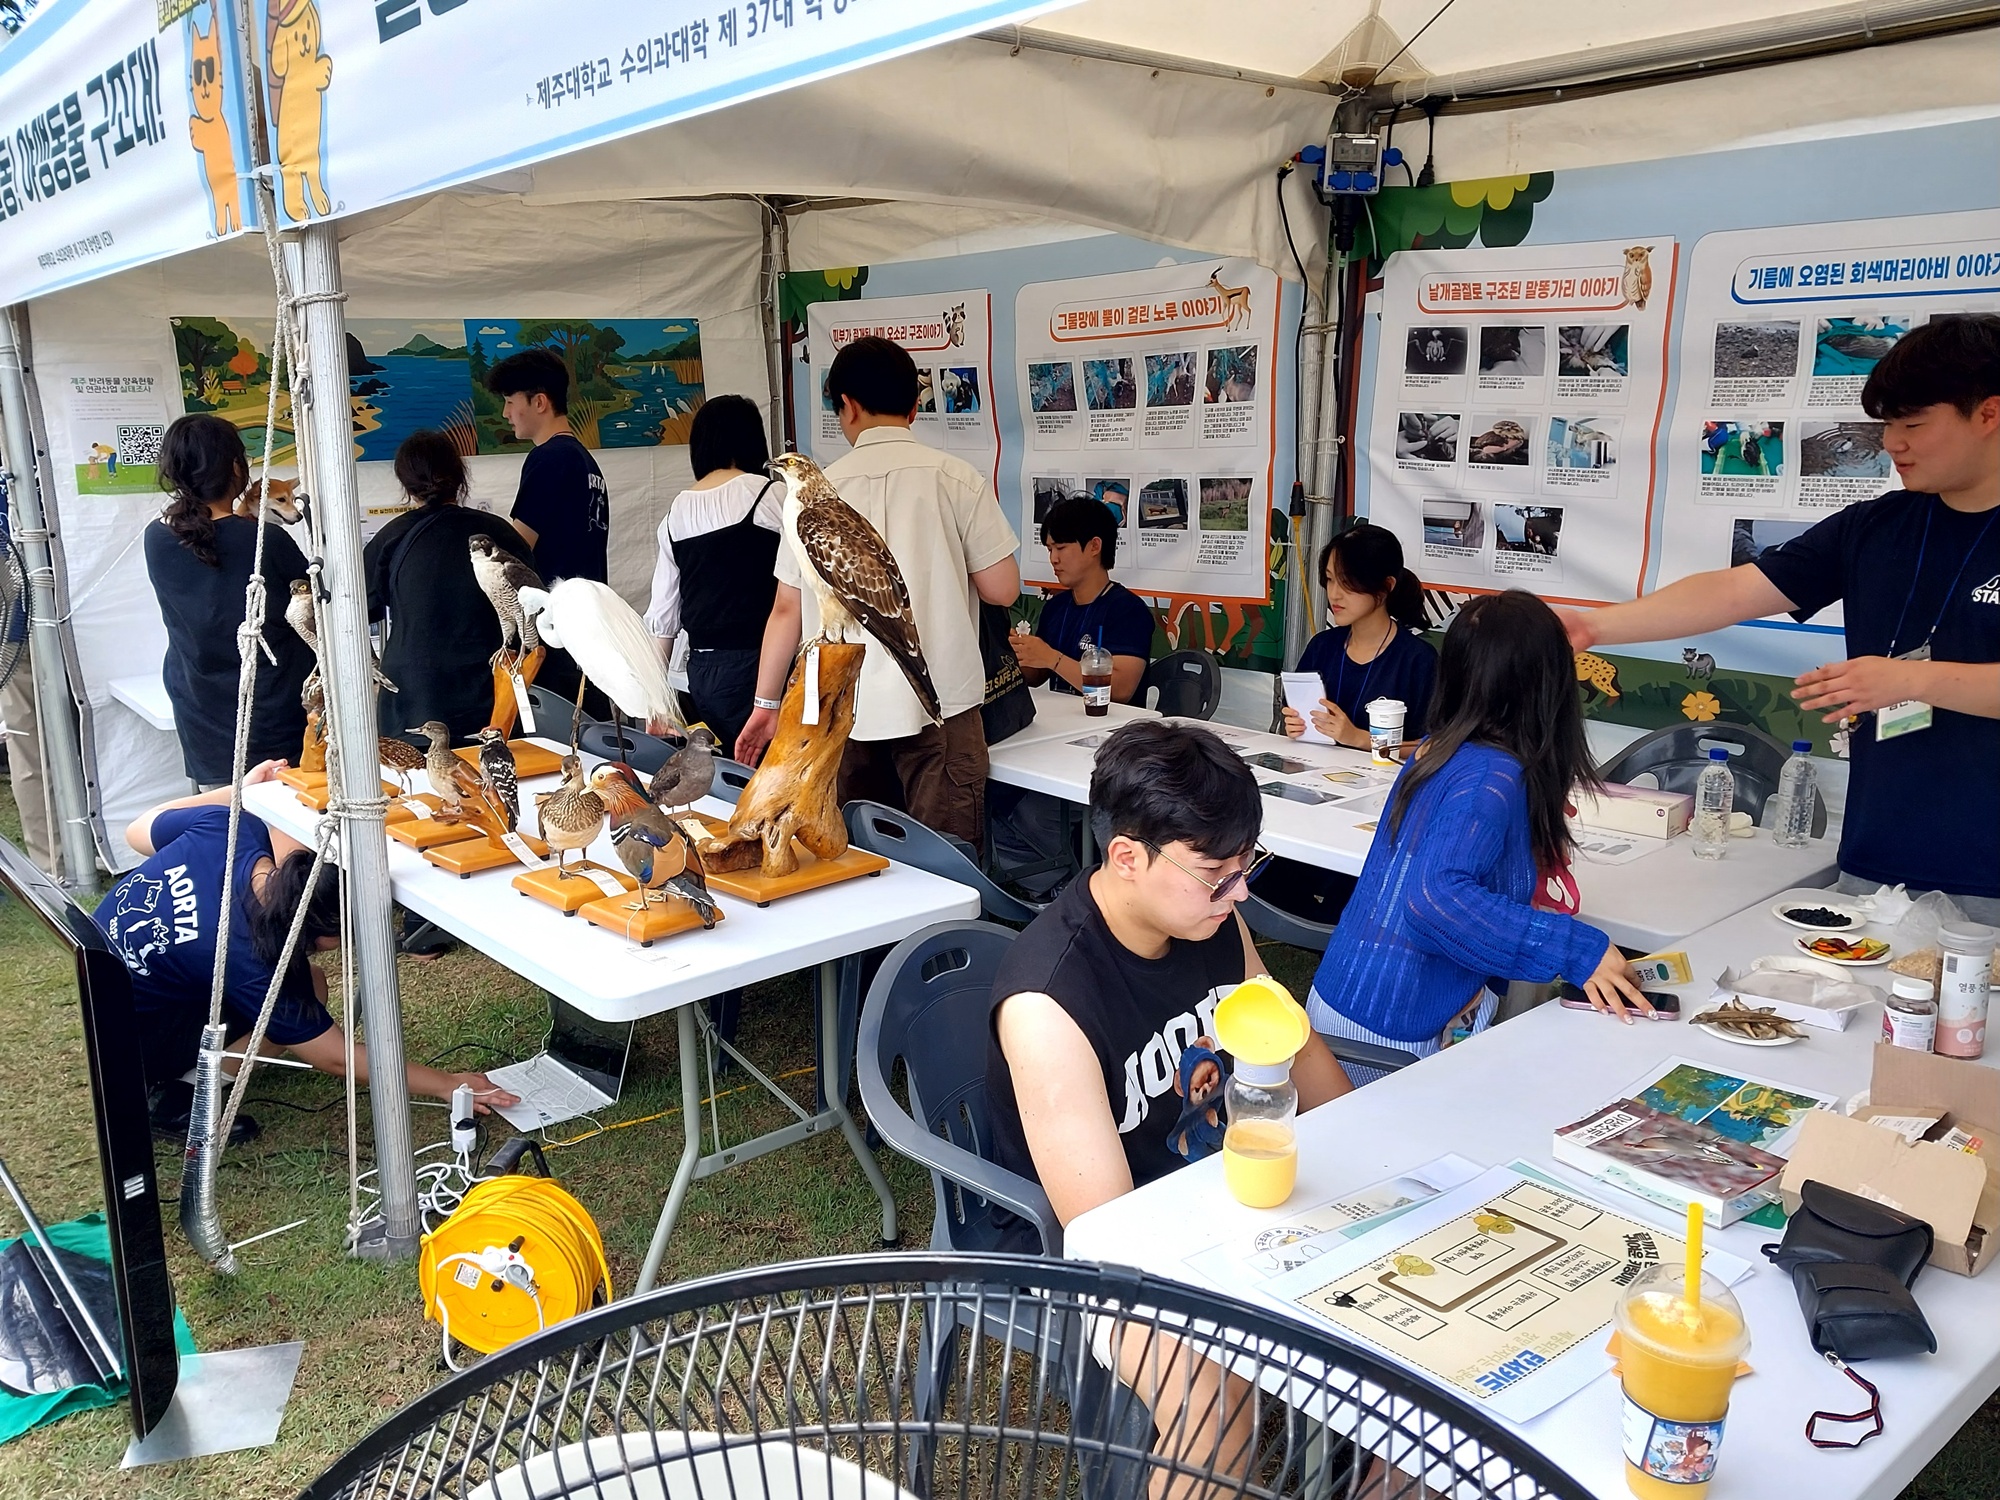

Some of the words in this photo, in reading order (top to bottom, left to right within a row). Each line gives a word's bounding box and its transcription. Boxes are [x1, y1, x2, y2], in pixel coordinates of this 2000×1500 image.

[536, 58, 613, 110] 제주대학교
[619, 18, 710, 83] 수의과대학
[717, 8, 738, 48] 제
[16, 90, 91, 202] 야생동물
[86, 37, 166, 170] 구조대!
[1748, 265, 1794, 290] 기름에
[1797, 262, 1846, 287] 오염된
[1850, 256, 1950, 284] 회색머리아비
[1428, 282, 1483, 302] 날개골절로
[1485, 280, 1522, 301] 구조된
[1525, 278, 1575, 300] 말똥가리
[1580, 276, 1619, 298] 이야기
[1057, 310, 1099, 331] 그물망에
[1102, 308, 1124, 327] 뿔이
[1128, 305, 1150, 324] 걸린
[1153, 302, 1178, 322] 노루
[1182, 295, 1223, 318] 이야기
[886, 325, 908, 341] 오소리
[70, 377, 86, 385] 제주
[88, 377, 120, 386] 반려동물
[1972, 589, 2000, 605] STA
[994, 670, 1011, 689] SAFE
[164, 864, 199, 945] AORTA
[1958, 982, 1977, 994] 열풍
